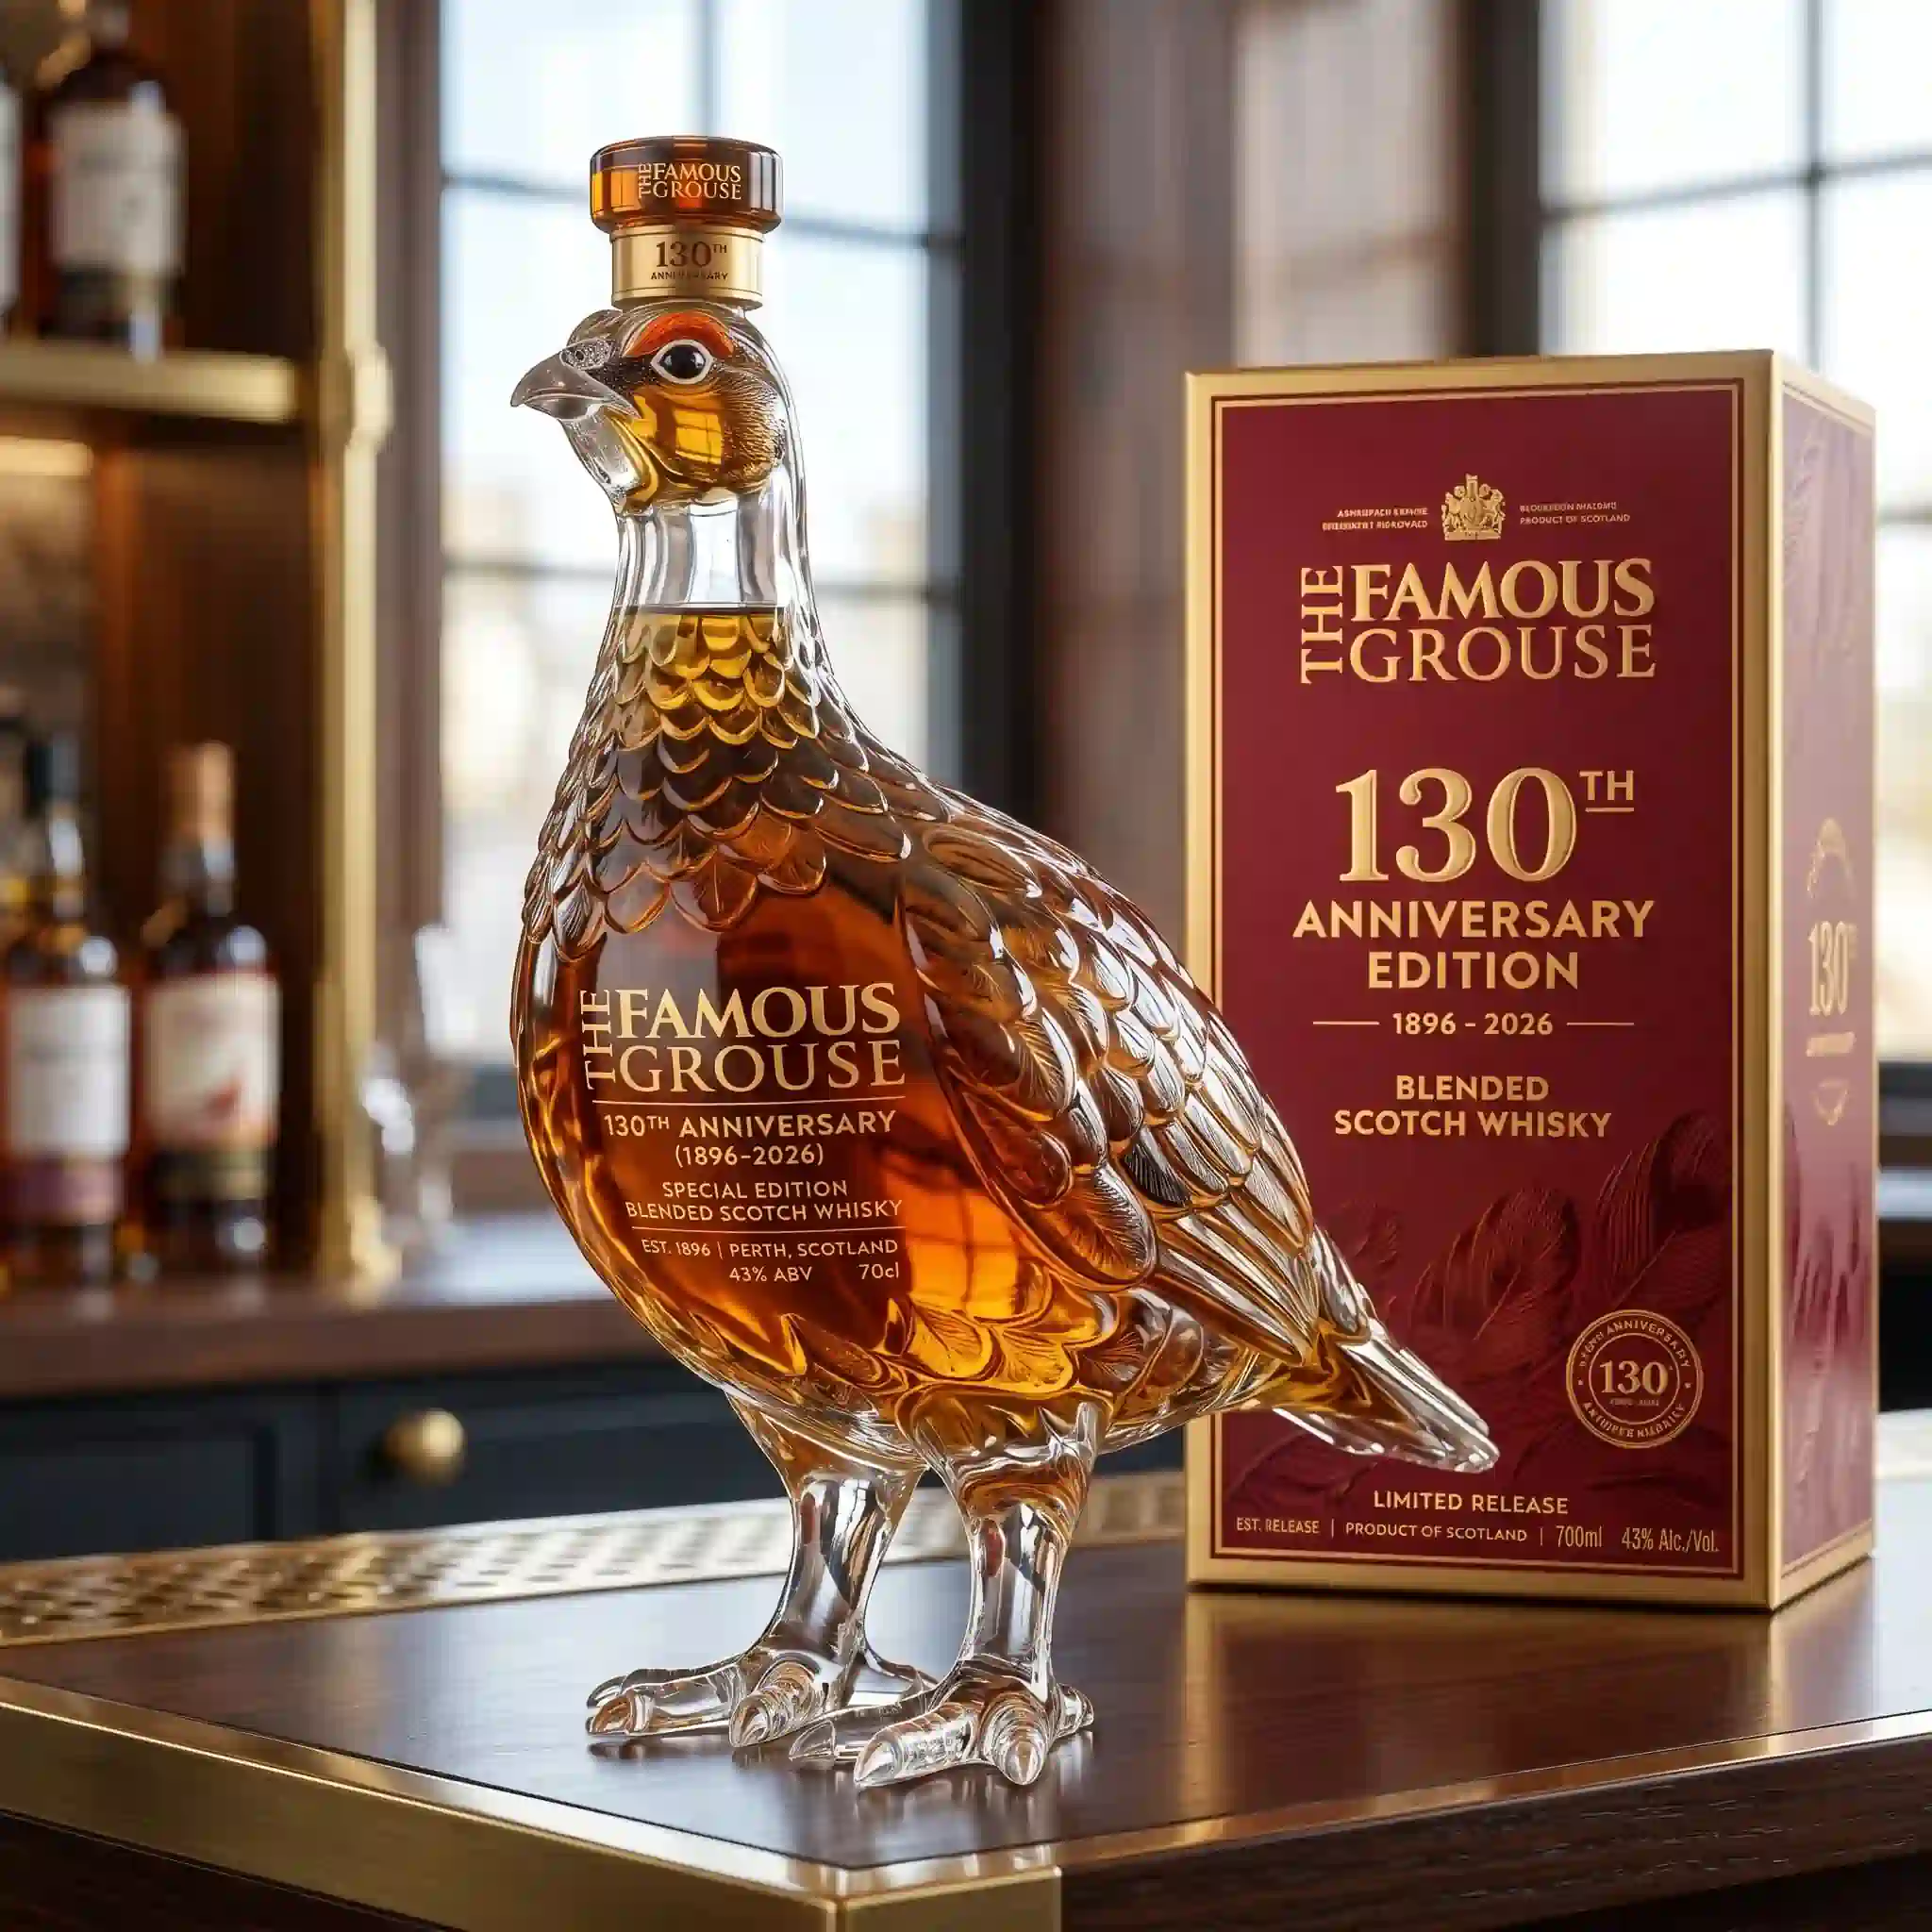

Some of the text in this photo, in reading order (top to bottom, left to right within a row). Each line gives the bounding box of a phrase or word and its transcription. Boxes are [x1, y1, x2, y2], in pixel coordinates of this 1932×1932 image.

[652, 162, 741, 183] FAMOUS
[652, 181, 741, 200] GROUSE
[656, 241, 727, 268] 130TH
[651, 271, 728, 281] ANNIARY
[1580, 513, 1631, 524] SCOTLAND
[1350, 558, 1655, 623] FAMOUS
[1300, 565, 1343, 684] THE
[1349, 624, 1657, 683] GROUSE
[1335, 767, 1635, 882] 130TH
[1292, 899, 1656, 939] ANNIVERSARY
[1368, 951, 1579, 991] EDITION
[615, 982, 901, 1039] FAMOUS
[1392, 1012, 1457, 1036] 1896
[1484, 1011, 1554, 1036] 2026
[580, 990, 616, 1091] THE
[619, 1040, 906, 1093] GROUSE
[1395, 1074, 1550, 1102] BLENDED
[604, 1110, 896, 1138] 130TH ANNIVERSARY
[1334, 1109, 1612, 1139] SCOTCH WHISKY
[675, 1143, 824, 1169] (1896-2026)
[662, 1179, 848, 1199] SPECIAL EDITION
[625, 1199, 903, 1222] BLENDED SCOTCH WHISKY
[641, 1239, 899, 1259] EST. 1896 PERTH, SCOTLAND
[729, 1261, 900, 1282] 43% ABV 70cl
[1599, 1359, 1669, 1395] 130
[1374, 1490, 1569, 1514] LIMITED RELEASE
[1236, 1517, 1261, 1532] EST.
[1265, 1518, 1321, 1534] RELEASE
[1345, 1522, 1418, 1537] PRODUCT
[1421, 1524, 1442, 1539] OF
[1446, 1525, 1528, 1542] SCOTLAND
[1557, 1524, 1604, 1548] 700ml
[1621, 1527, 1655, 1551] 43%
